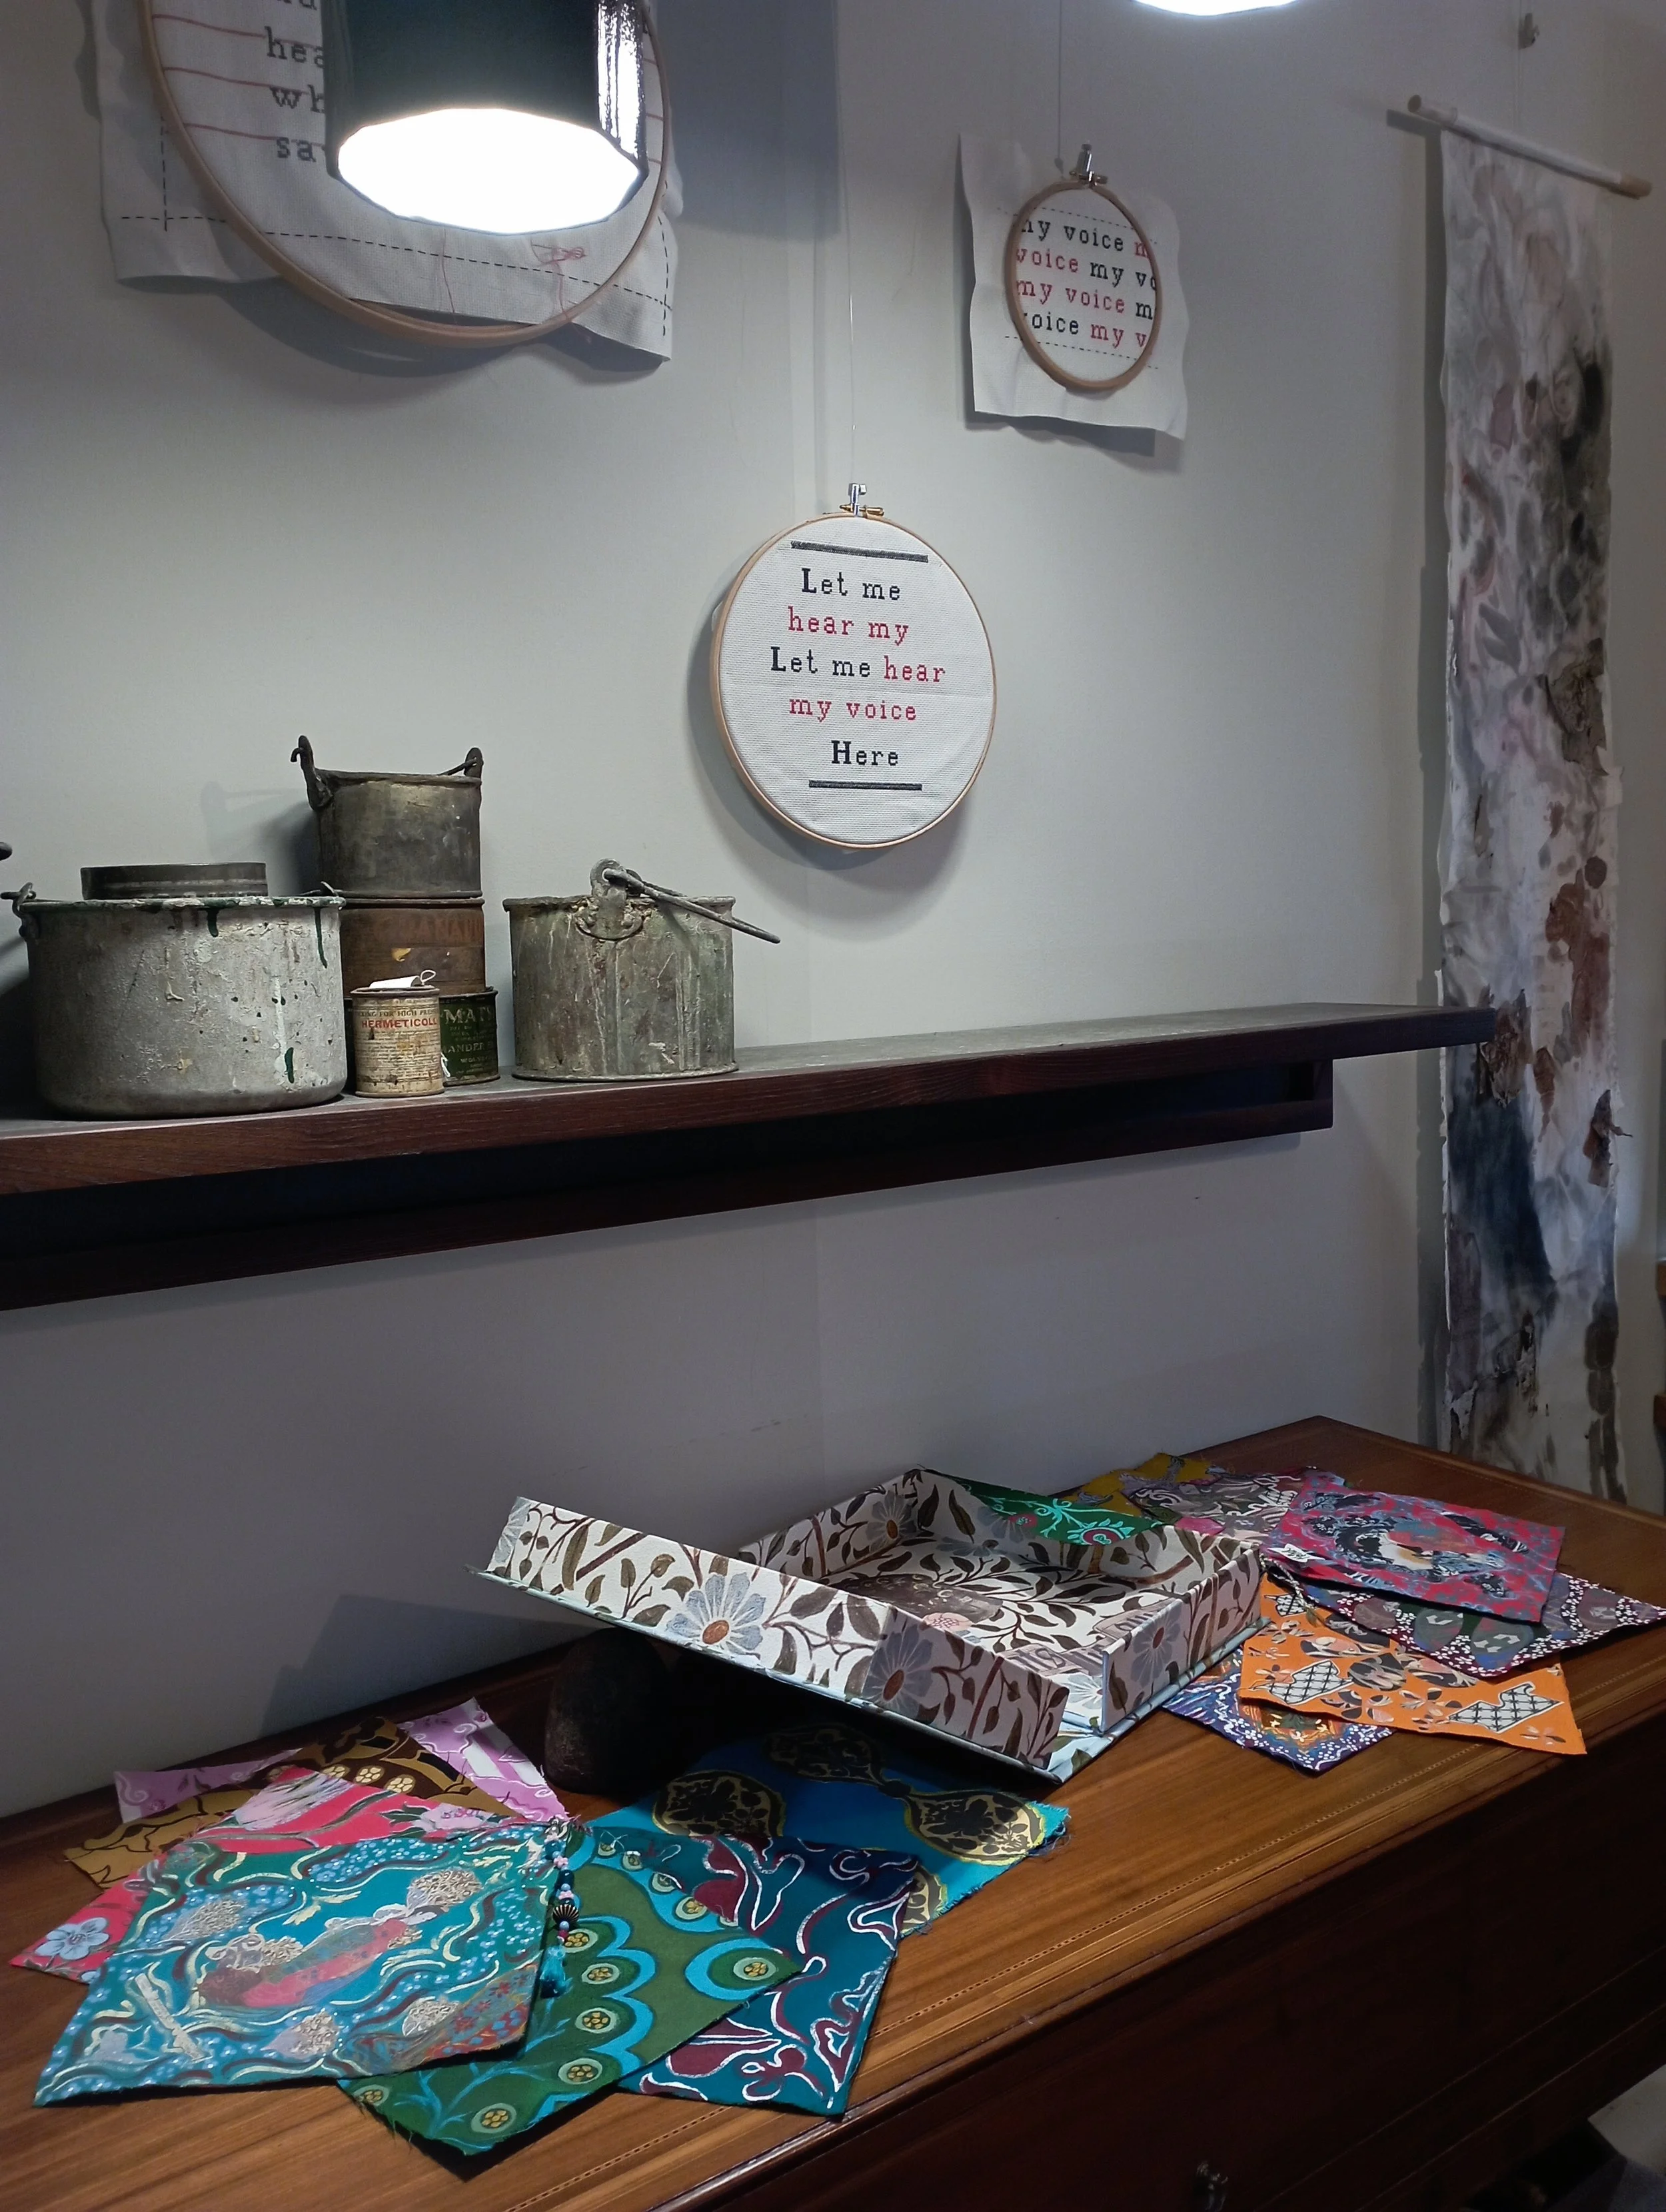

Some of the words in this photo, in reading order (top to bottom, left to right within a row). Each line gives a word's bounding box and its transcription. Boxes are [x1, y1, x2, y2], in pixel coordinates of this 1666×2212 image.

[1064, 225, 1124, 251] voice
[1016, 248, 1079, 273] voice
[1090, 261, 1124, 287] my
[1016, 280, 1053, 304] my
[1066, 287, 1125, 313] voice
[1024, 312, 1079, 334] oice
[1090, 323, 1124, 348] my
[802, 568, 848, 596] Let
[862, 582, 902, 600] me
[788, 606, 854, 635] hear
[868, 621, 909, 646] my
[770, 646, 818, 674] Let
[832, 660, 871, 678] me
[884, 655, 946, 683] hear
[789, 698, 832, 723] my
[846, 700, 917, 721] voice
[831, 740, 899, 766] Here
